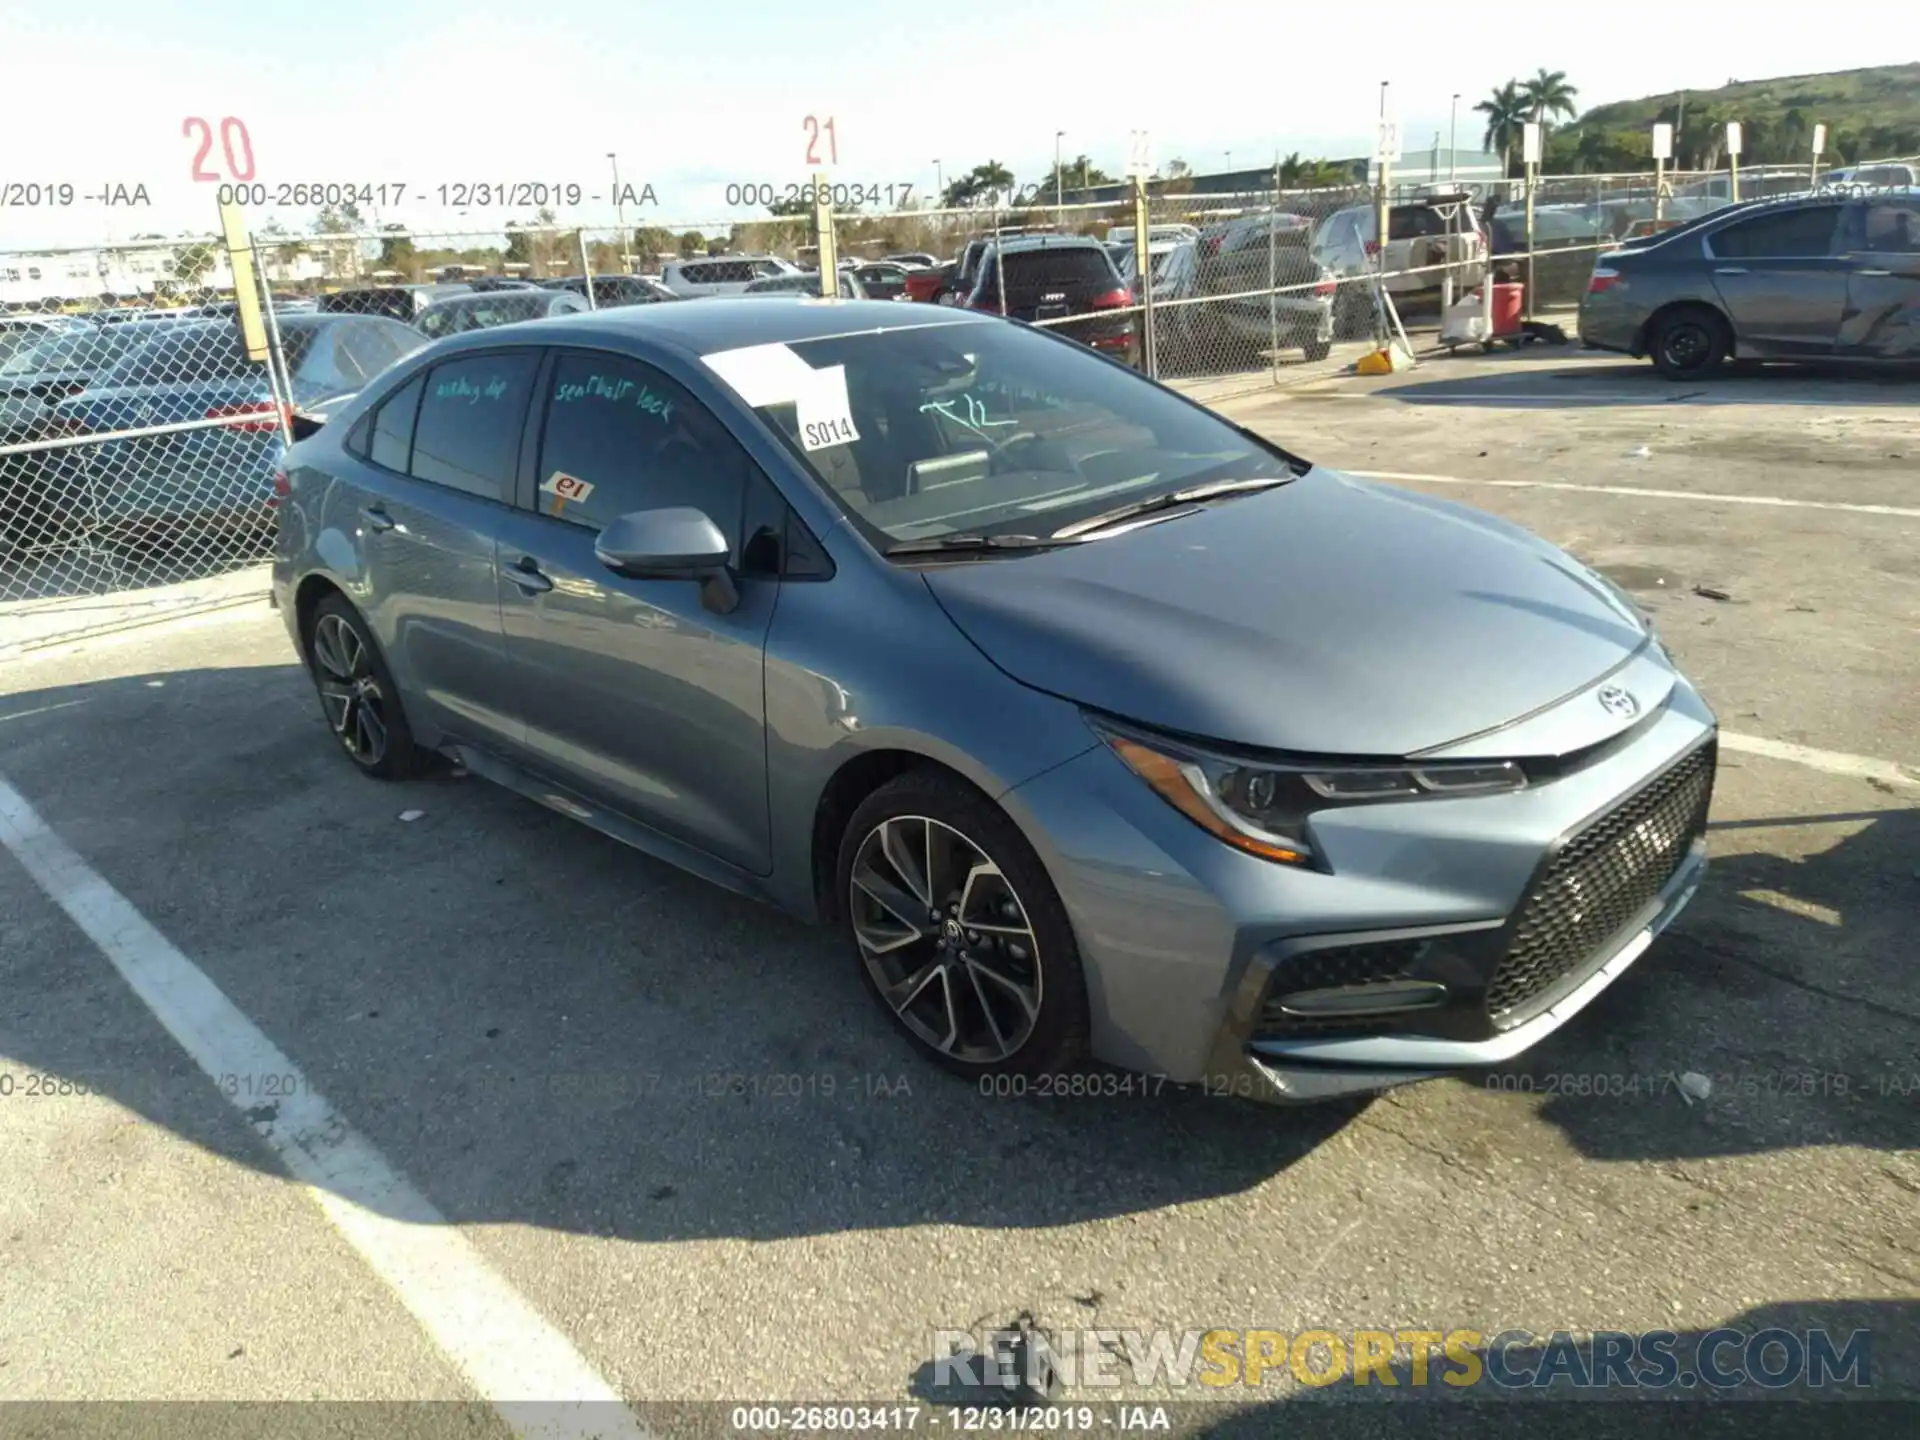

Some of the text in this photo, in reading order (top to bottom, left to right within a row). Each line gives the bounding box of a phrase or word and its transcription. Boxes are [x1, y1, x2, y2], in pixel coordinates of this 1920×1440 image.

[183, 116, 255, 182] 20
[803, 115, 837, 165] 21
[806, 417, 853, 446] S014
